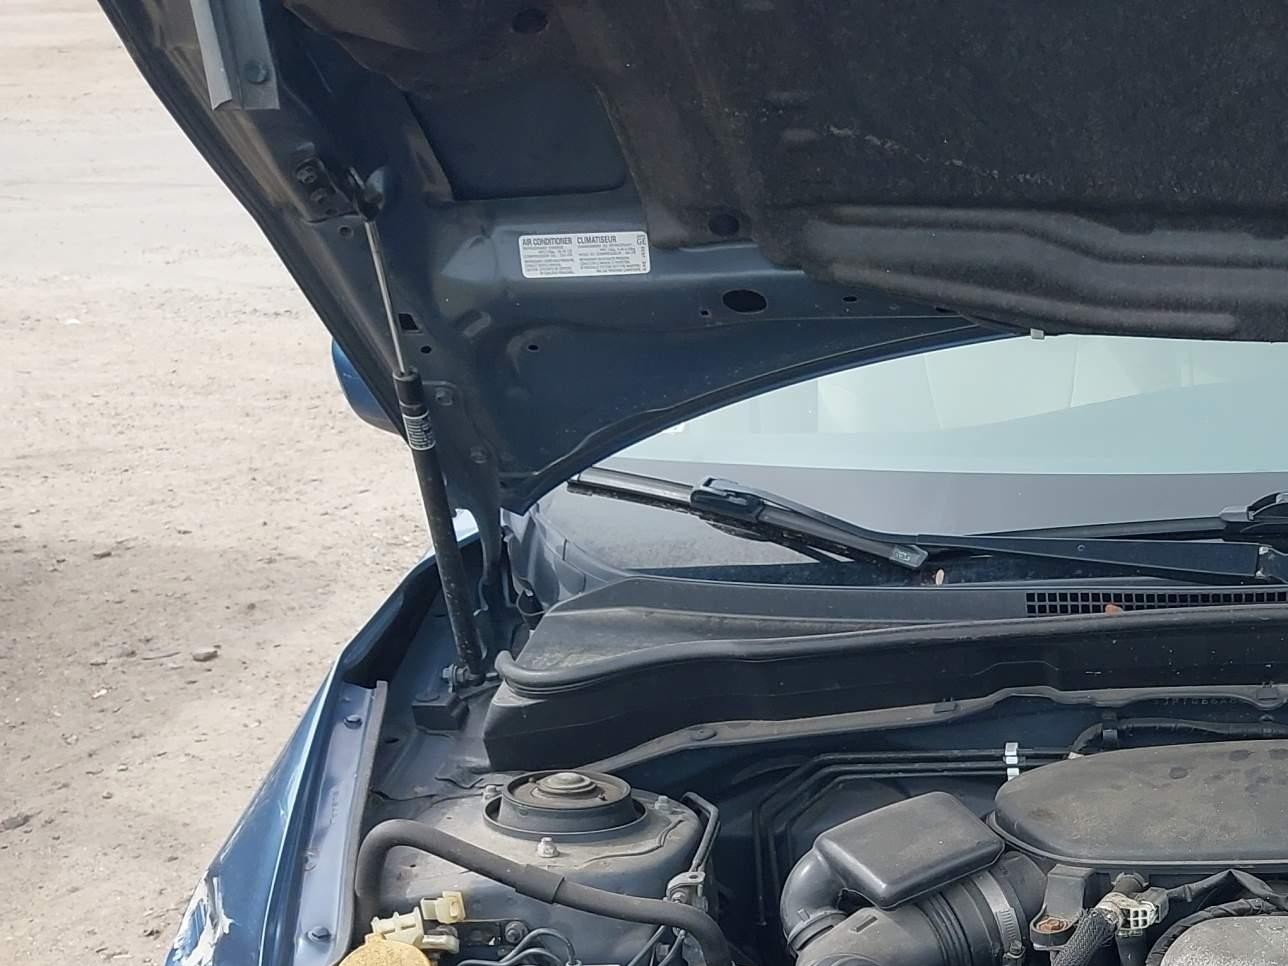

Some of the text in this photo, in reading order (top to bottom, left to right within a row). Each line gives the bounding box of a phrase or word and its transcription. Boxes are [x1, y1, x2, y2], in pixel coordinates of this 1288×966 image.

[522, 236, 573, 246] AIR CONDITIONER
[577, 235, 617, 244] CLIMATISEUR
